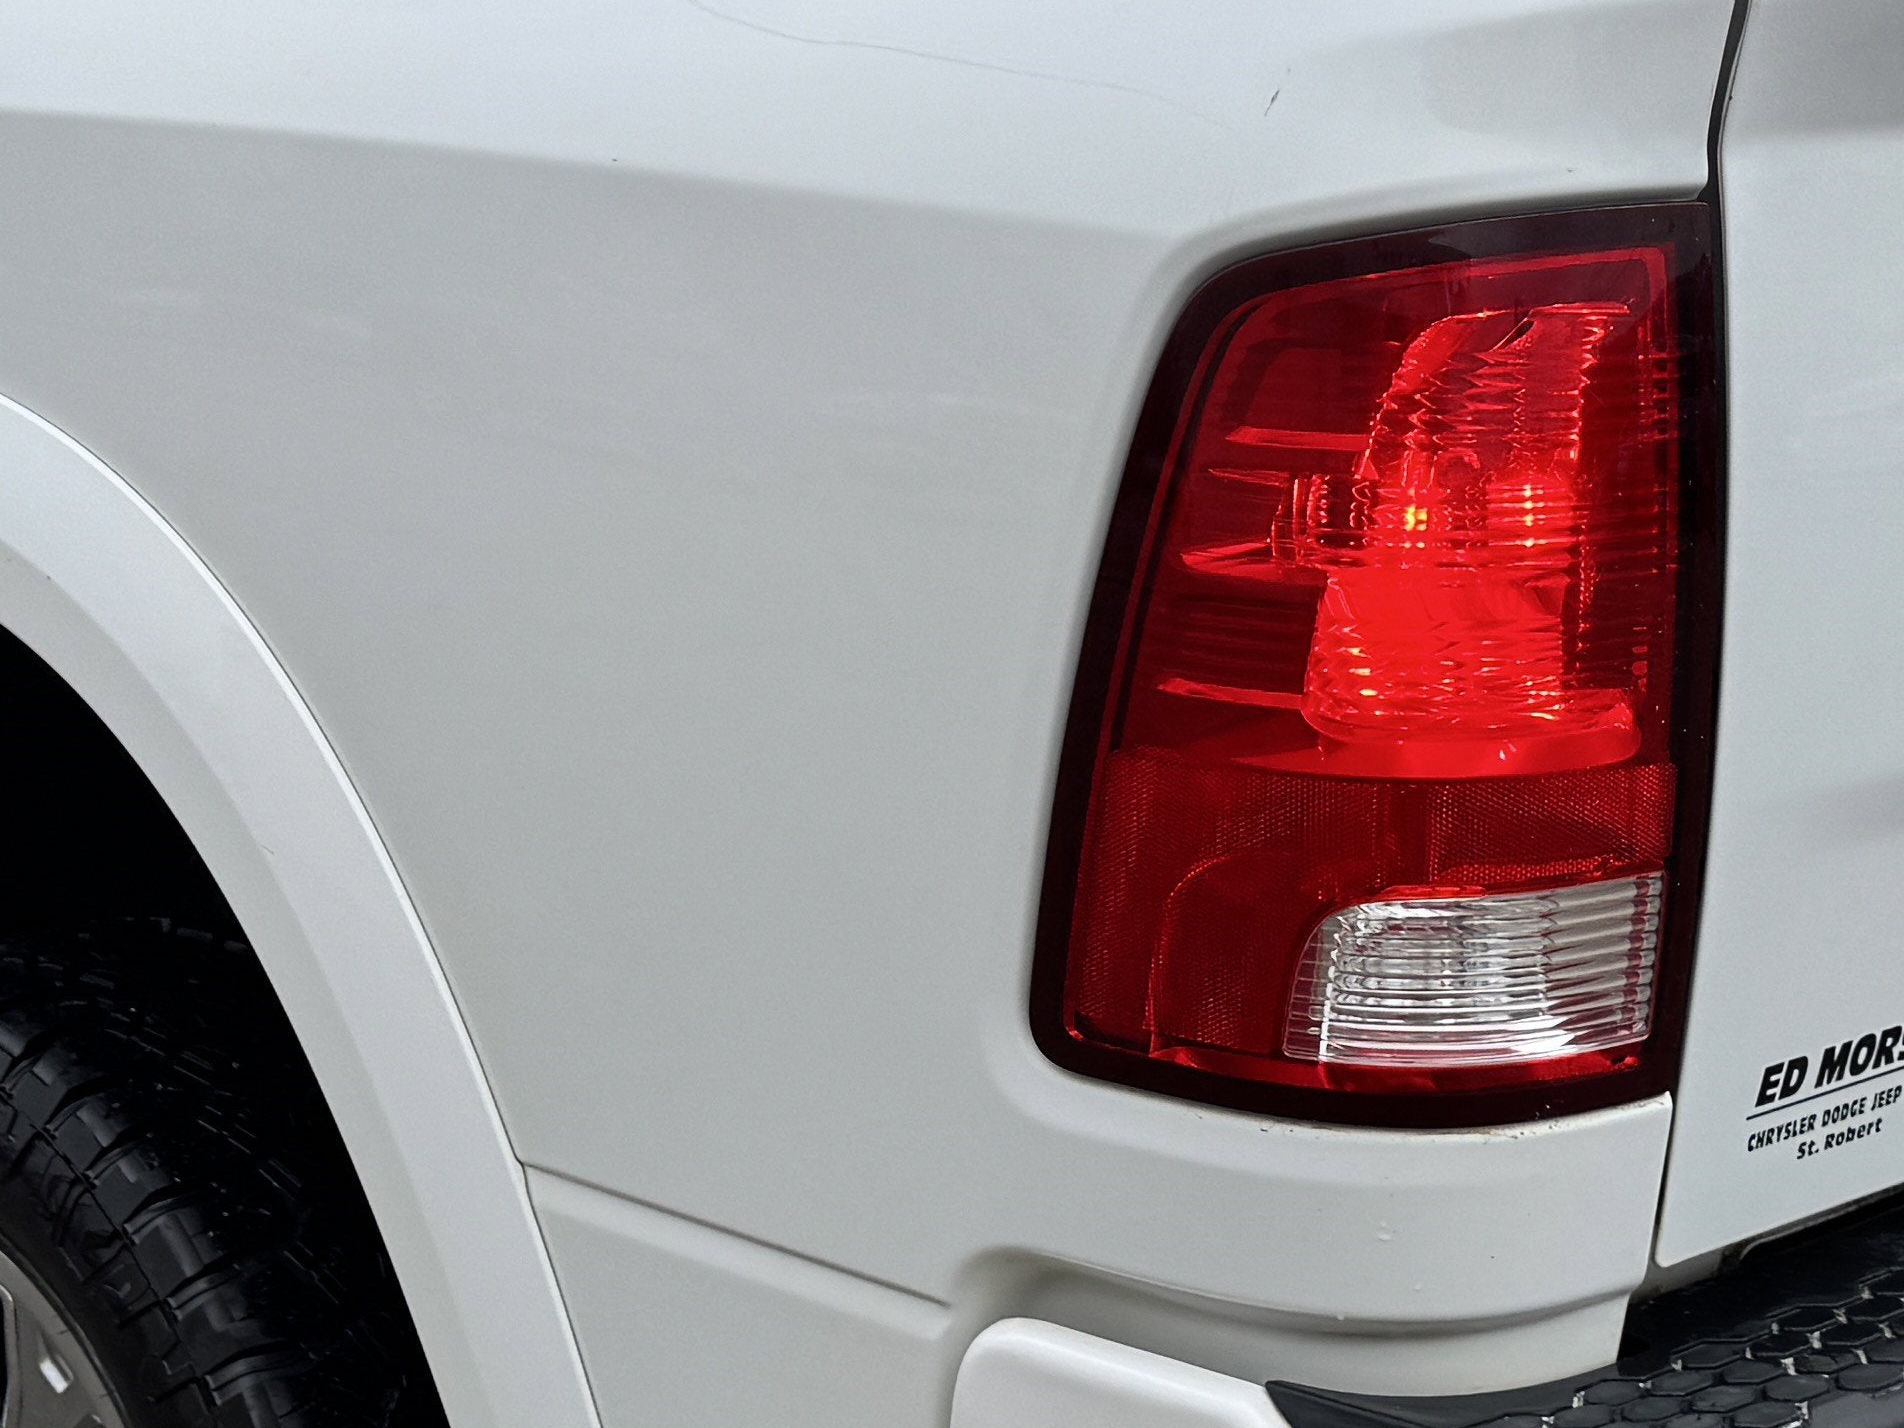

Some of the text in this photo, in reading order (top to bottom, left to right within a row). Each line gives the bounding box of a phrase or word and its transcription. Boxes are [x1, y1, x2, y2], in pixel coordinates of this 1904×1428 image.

[1755, 1055, 1808, 1108] ED
[1747, 1114, 1817, 1152] CHRYSLER
[1821, 1096, 1867, 1128] DODGE
[1871, 1085, 1902, 1112] JEEP
[1797, 1118, 1884, 1160] St. Robert
